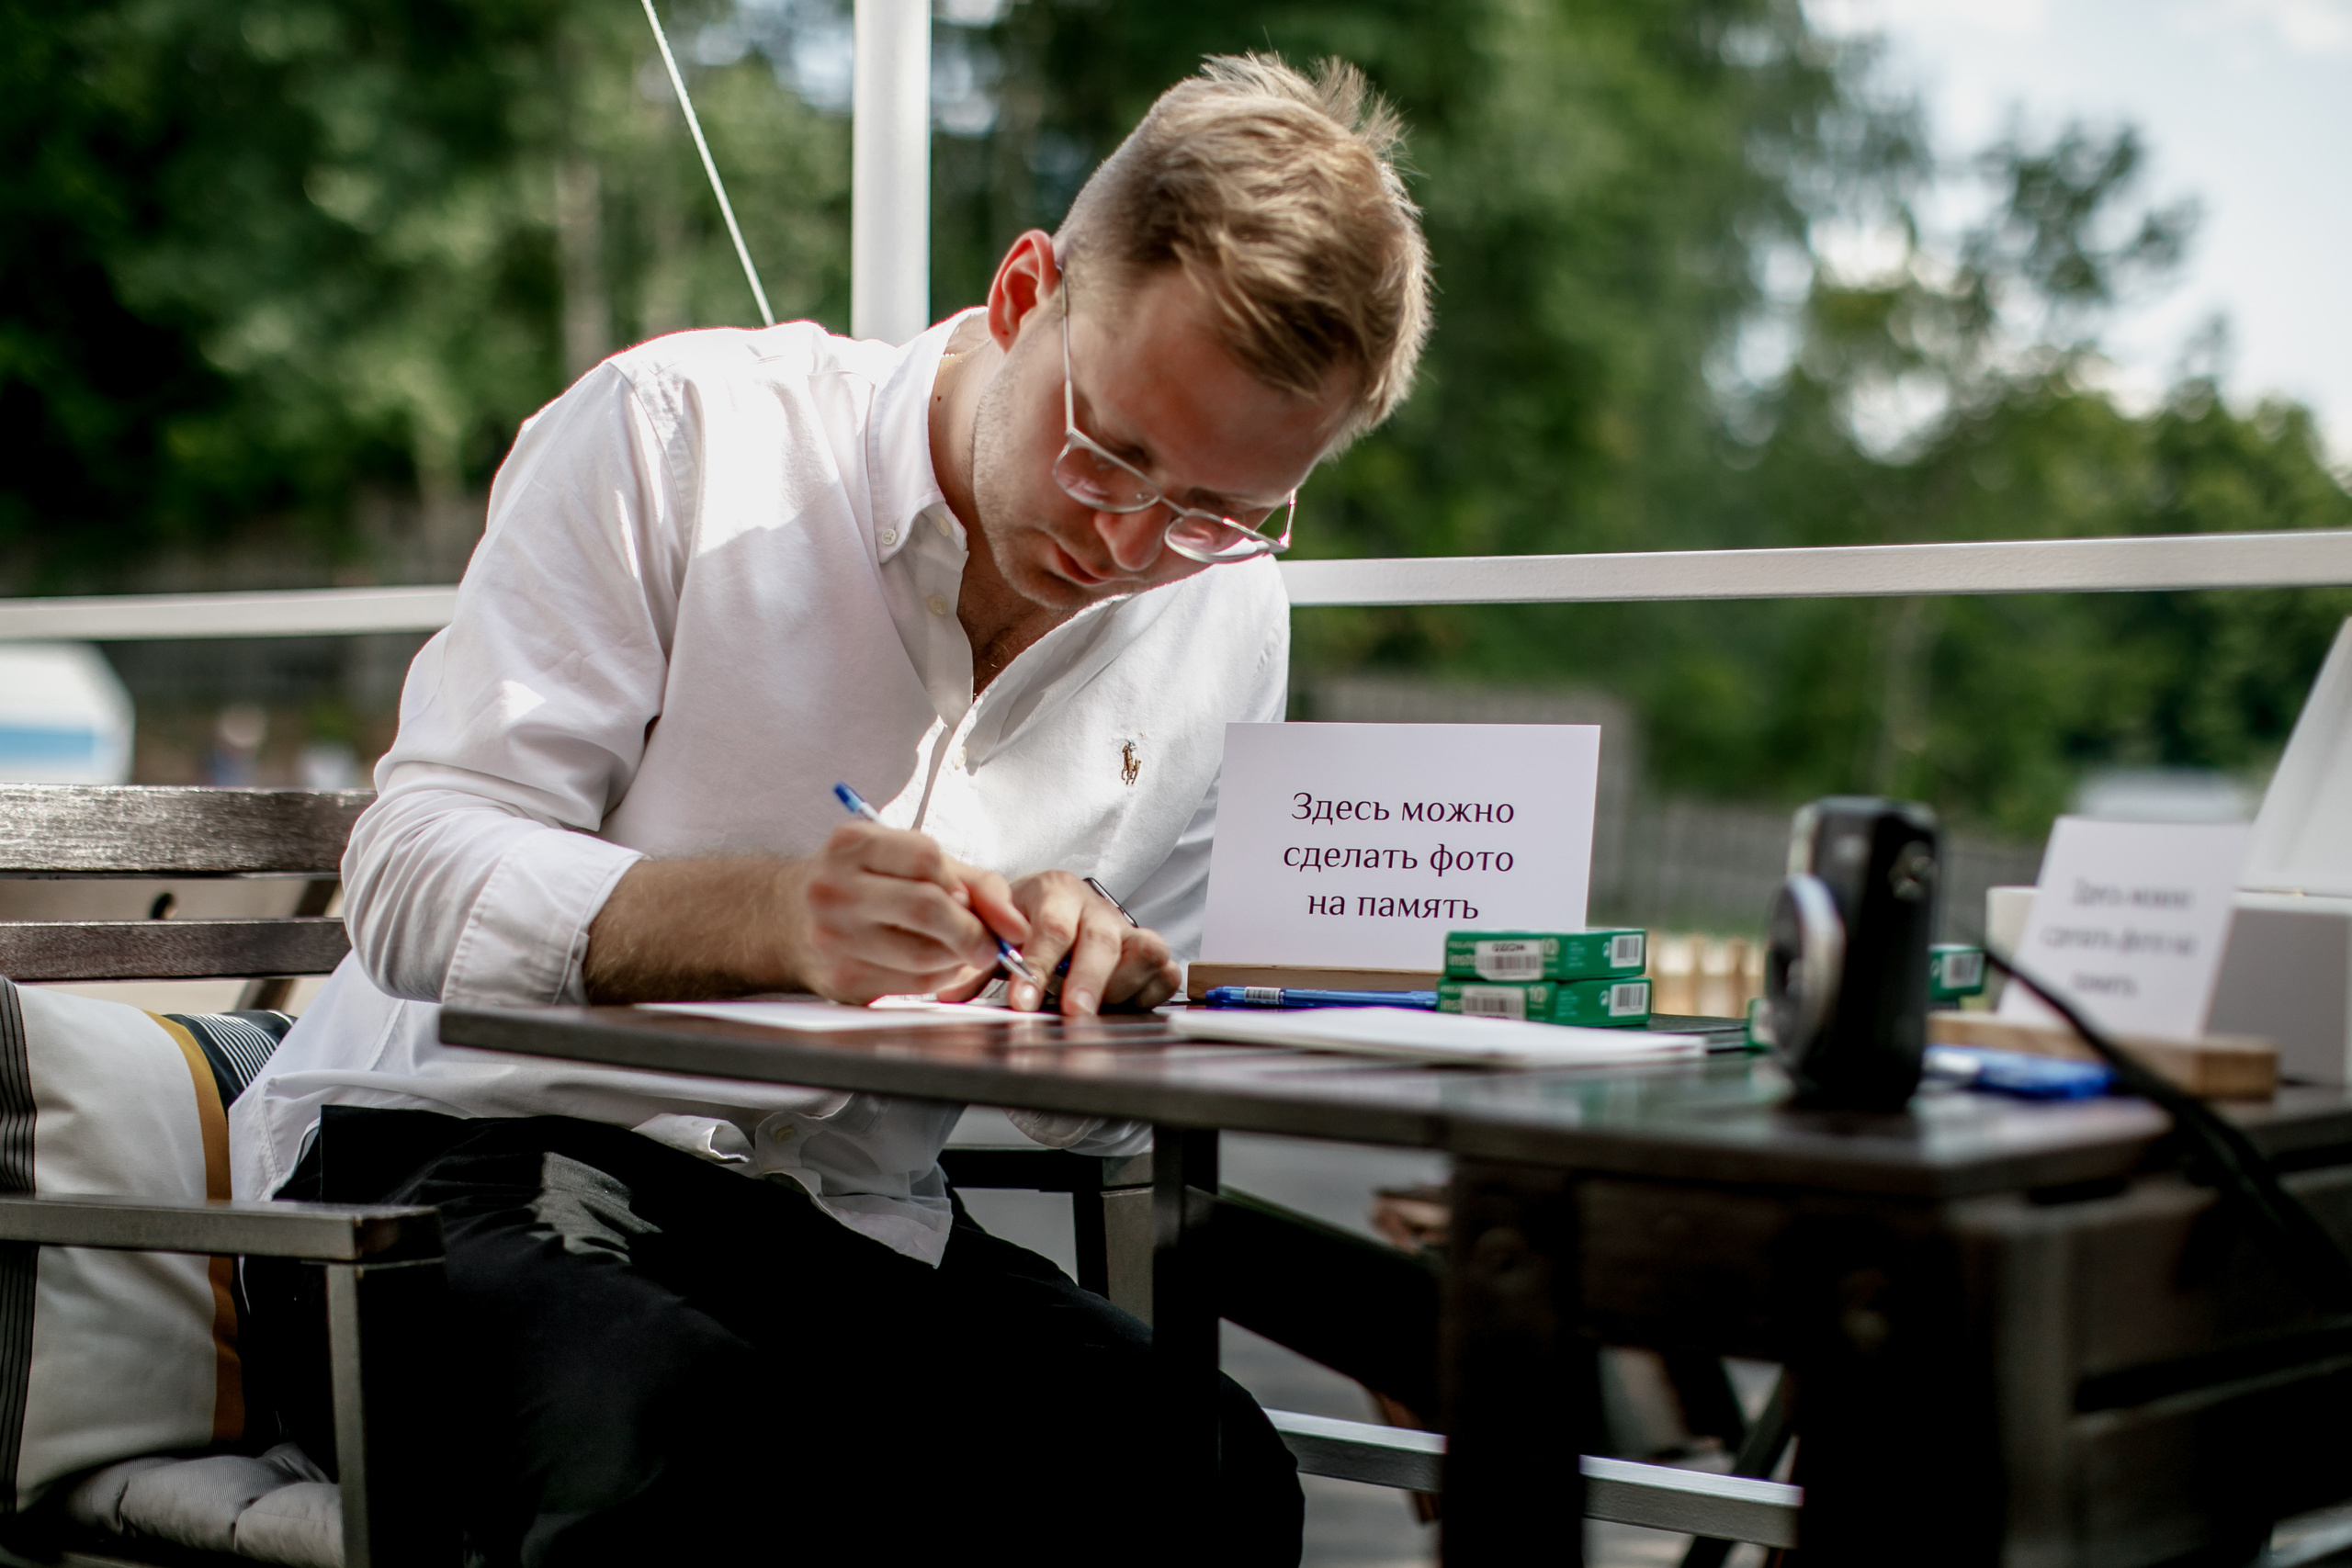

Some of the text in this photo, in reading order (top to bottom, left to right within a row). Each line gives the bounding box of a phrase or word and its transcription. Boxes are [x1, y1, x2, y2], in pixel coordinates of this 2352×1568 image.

[1291, 792, 1515, 825] Здесь можно
[1283, 843, 1514, 877] сделать фото
[1307, 895, 1479, 919] на память
